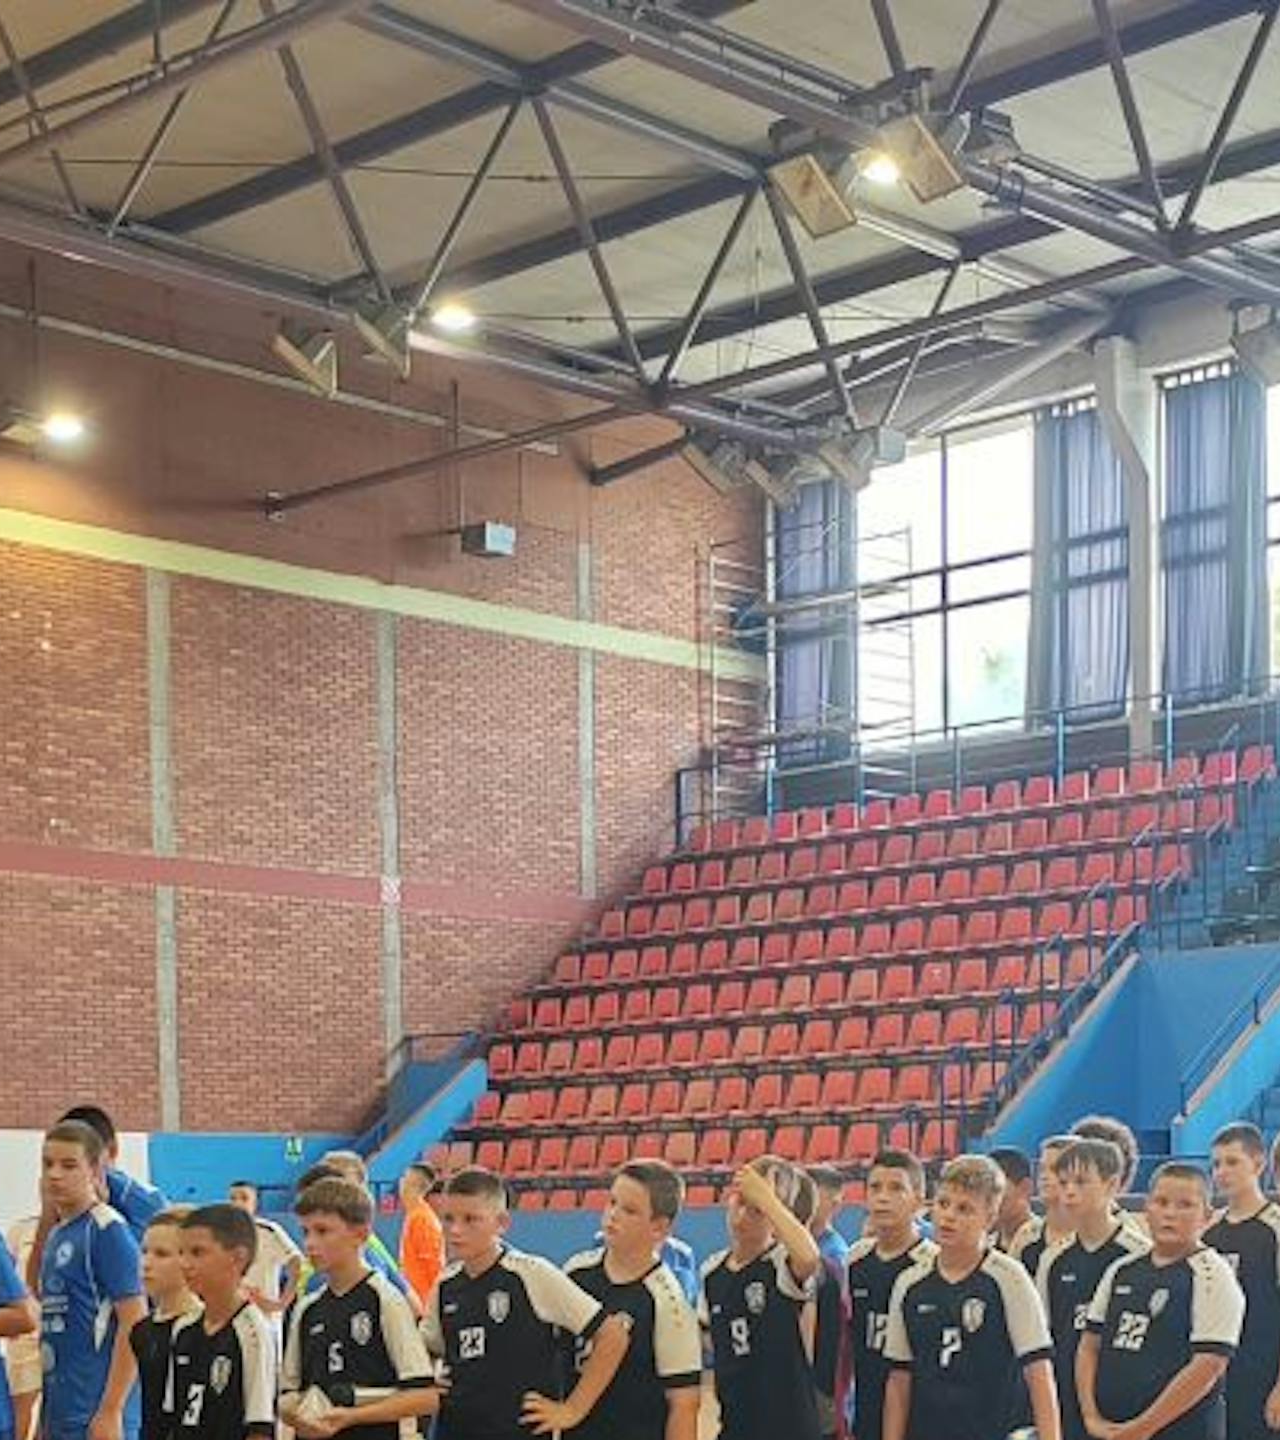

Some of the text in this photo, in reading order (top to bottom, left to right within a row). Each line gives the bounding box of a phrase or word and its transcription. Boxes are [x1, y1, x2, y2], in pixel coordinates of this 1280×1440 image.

[459, 1326, 486, 1359] 23
[938, 1327, 962, 1368] 7
[182, 1384, 206, 1426] 3
